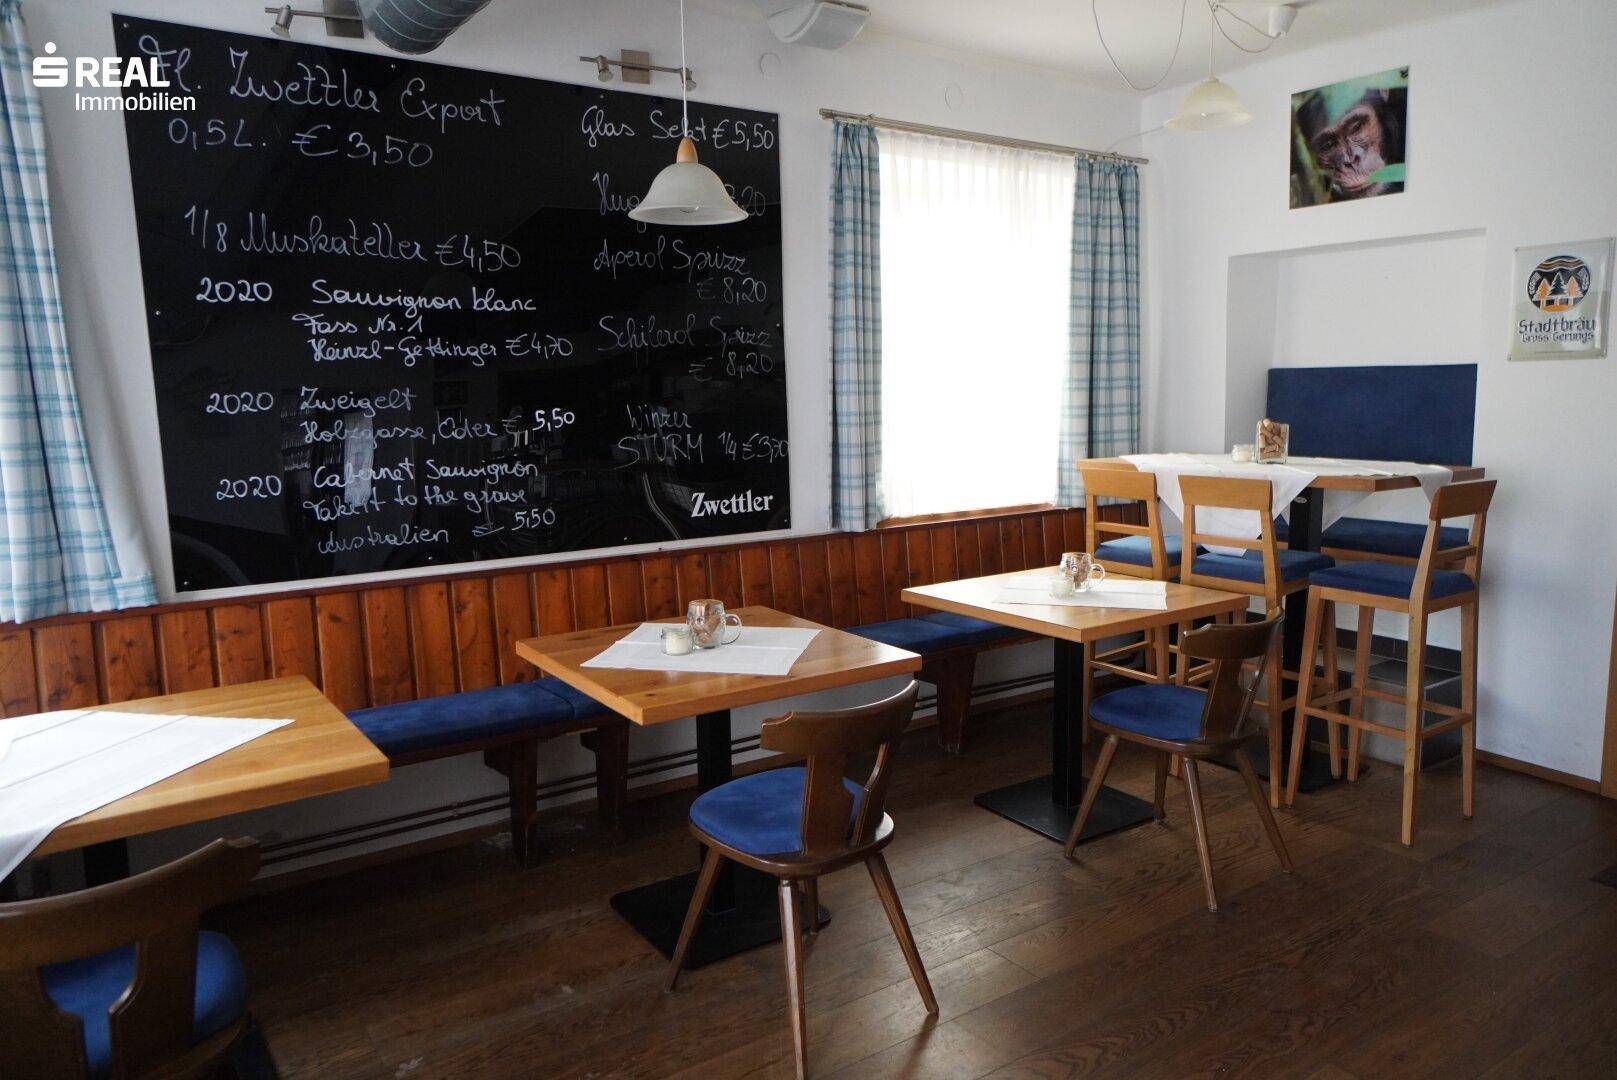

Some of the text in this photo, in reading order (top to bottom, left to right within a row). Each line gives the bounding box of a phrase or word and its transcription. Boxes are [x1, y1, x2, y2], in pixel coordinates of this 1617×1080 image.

[228, 46, 380, 114] Zwettler
[581, 105, 636, 148] Glas
[240, 211, 427, 262] Muskateller
[593, 235, 666, 280] Aperol
[196, 276, 273, 302] 2020
[311, 279, 537, 318] Sauvignon blanc
[1518, 317, 1596, 334] Stadtbräu
[205, 391, 274, 415] 2020
[300, 386, 417, 418] Zweigelt
[216, 474, 282, 500] 2020
[426, 459, 539, 485] Sauvignon
[690, 489, 774, 518] Zwettler
